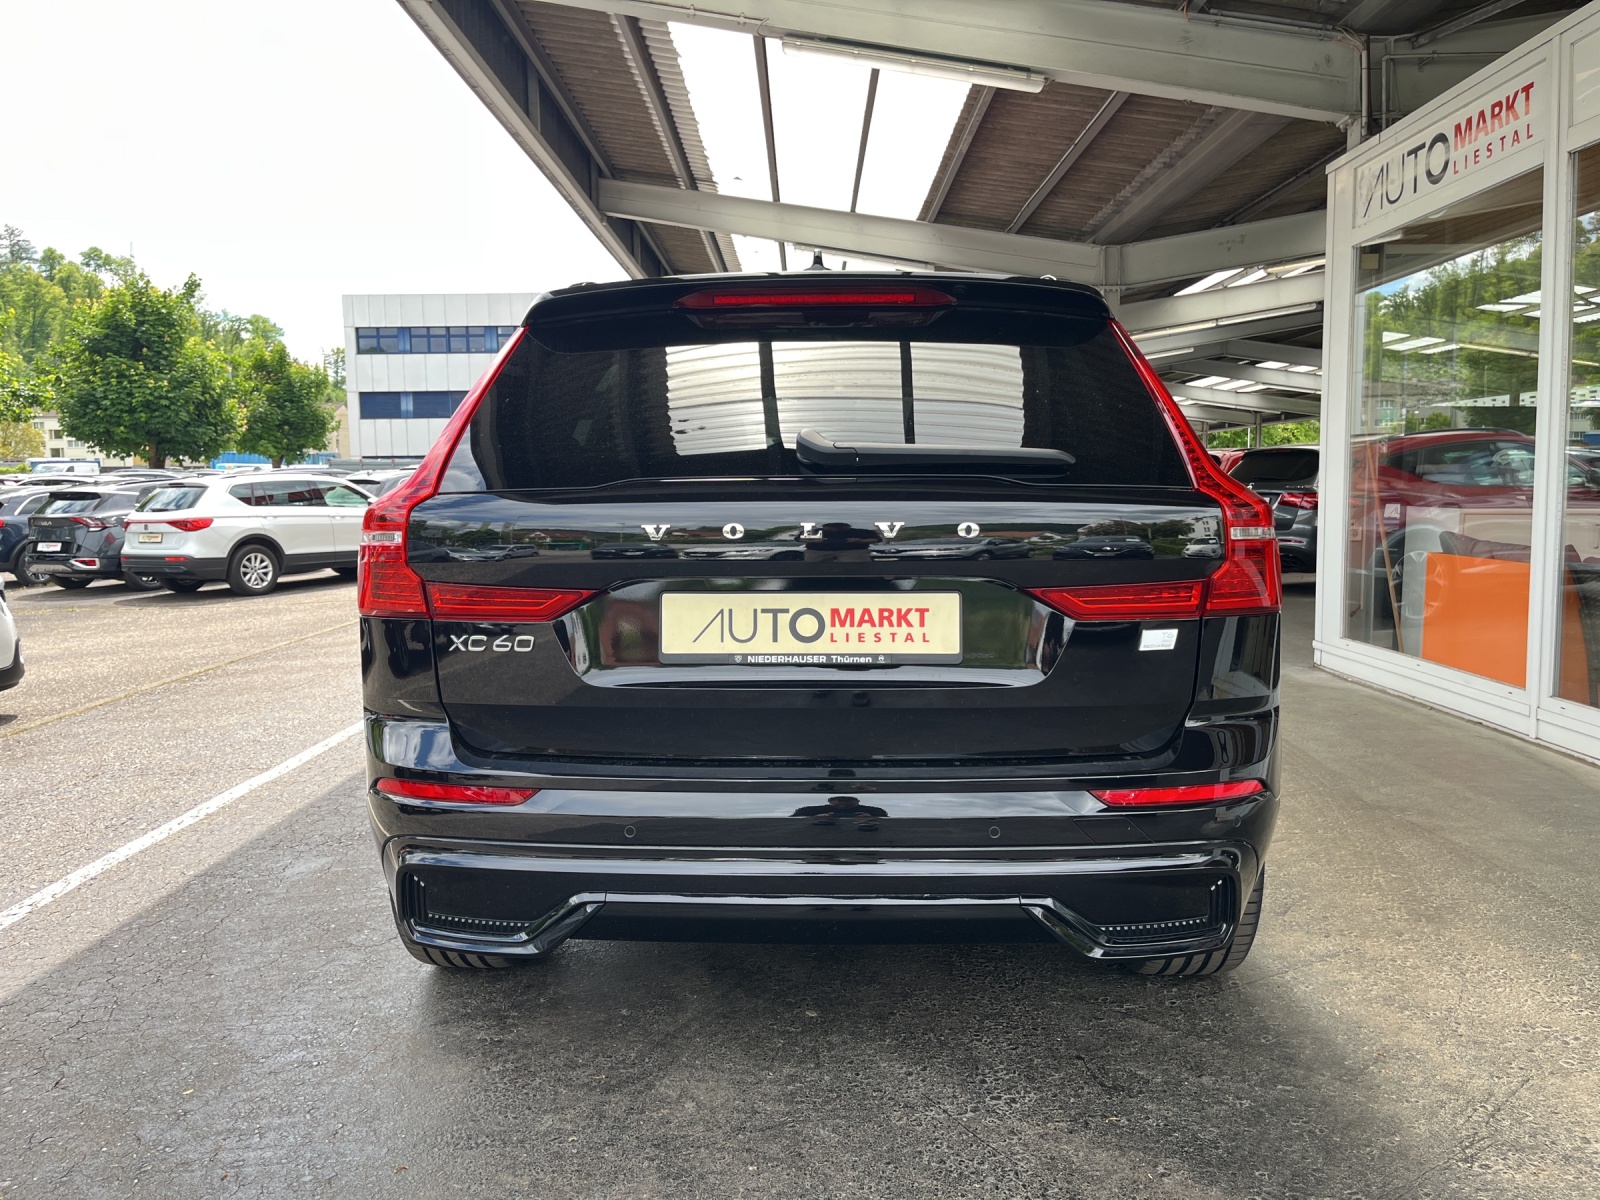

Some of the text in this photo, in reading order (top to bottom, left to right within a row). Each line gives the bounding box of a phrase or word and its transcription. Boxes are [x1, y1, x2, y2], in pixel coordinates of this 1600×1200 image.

[1363, 81, 1535, 218] AUTO MARKT
[1453, 123, 1534, 175] LIESTAL
[641, 522, 980, 541] VOLVO
[692, 607, 930, 644] AUTO MARKT
[830, 632, 930, 643] LIESTAL
[747, 655, 873, 663] NIEDERHAUSER Thürnen
